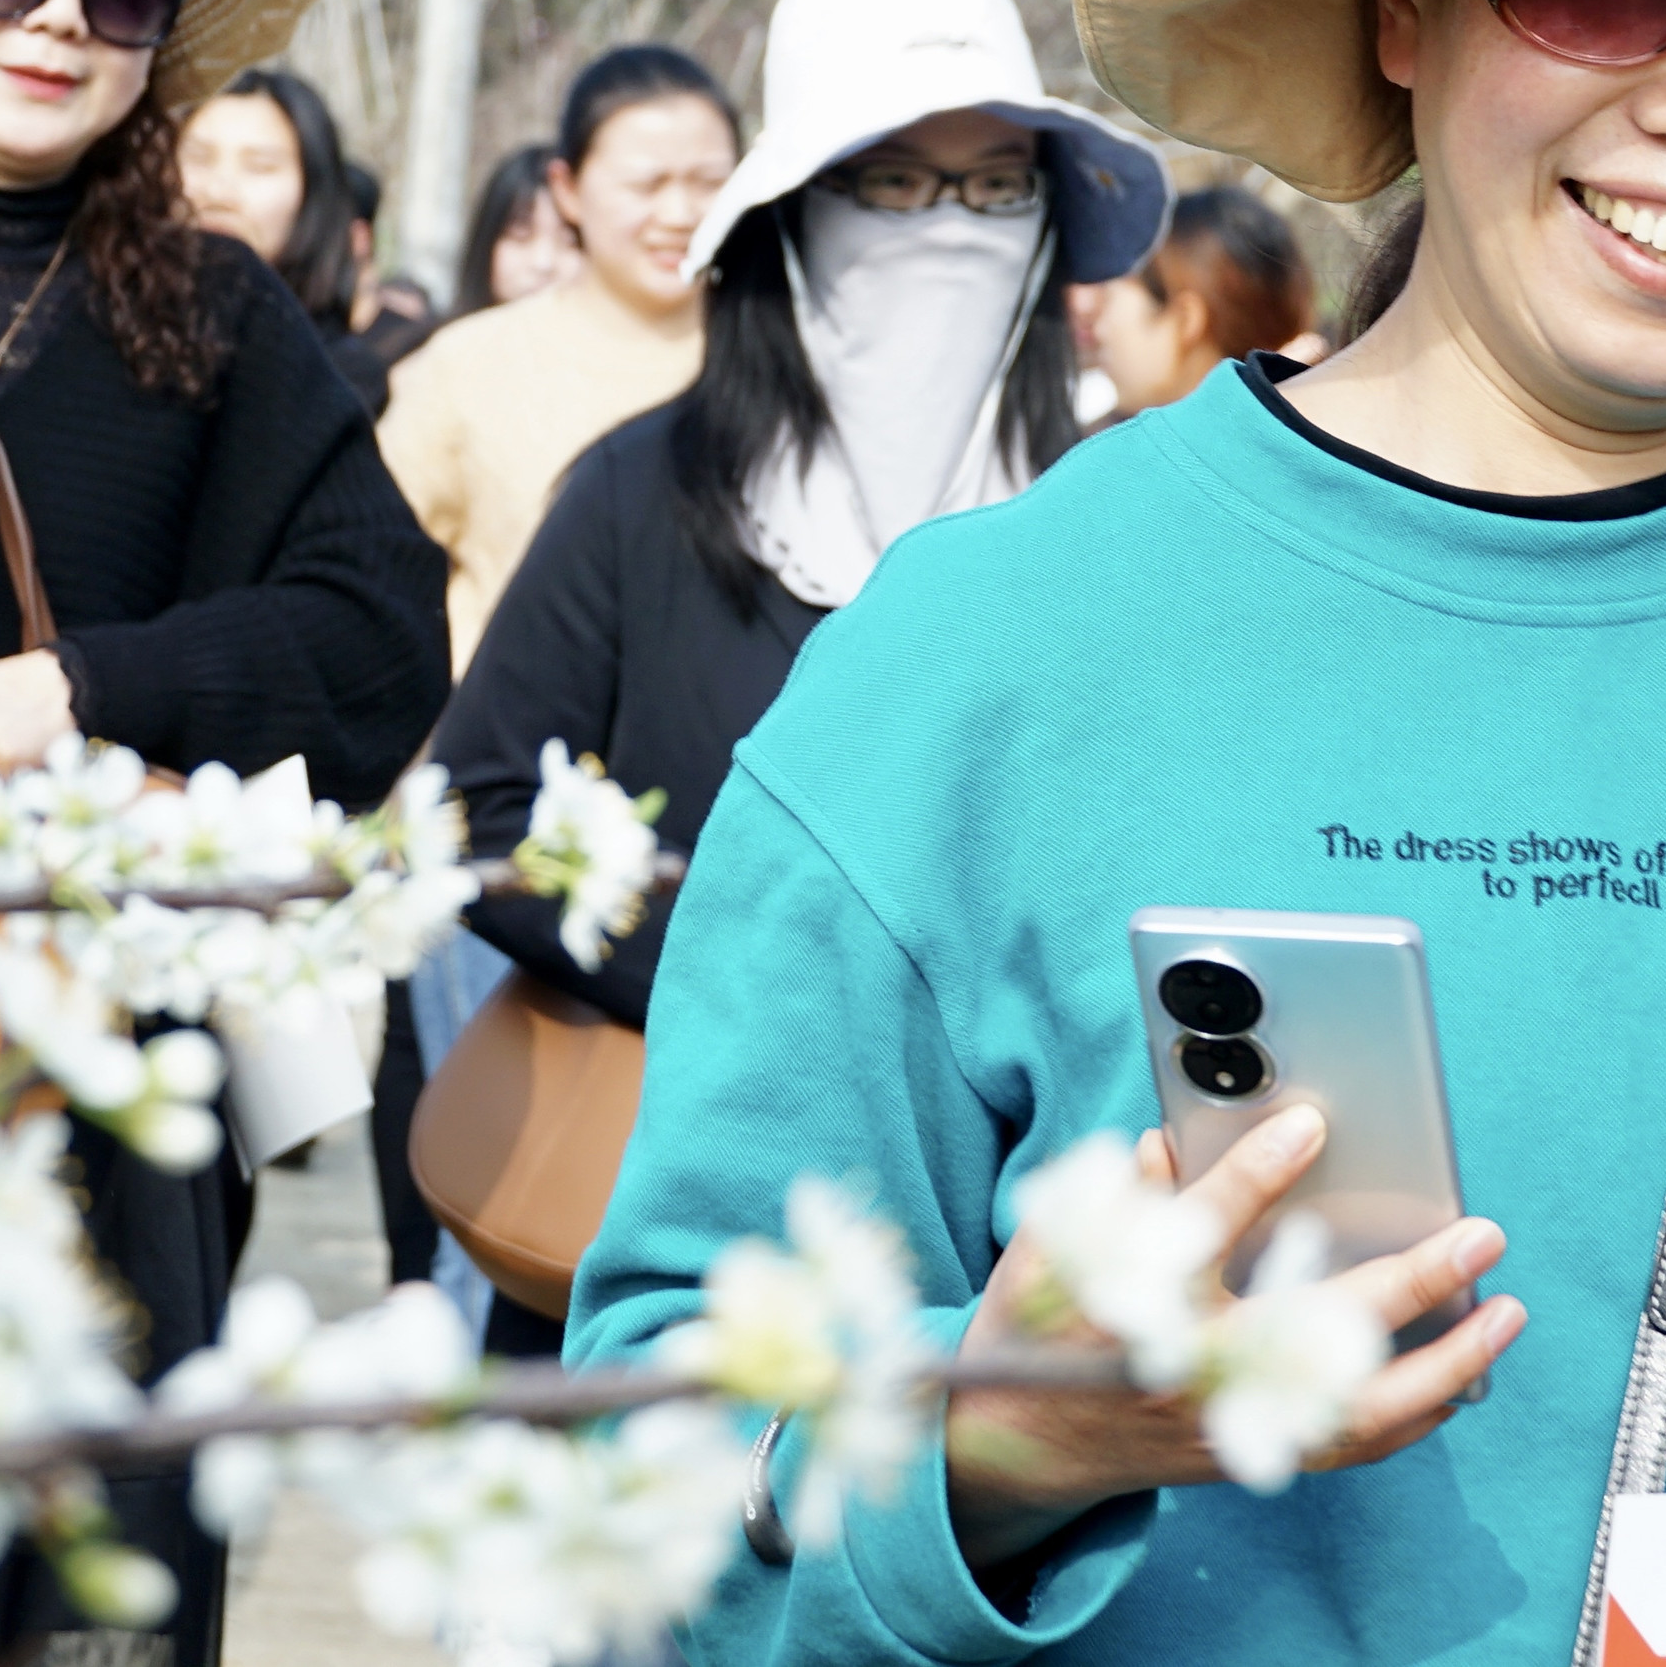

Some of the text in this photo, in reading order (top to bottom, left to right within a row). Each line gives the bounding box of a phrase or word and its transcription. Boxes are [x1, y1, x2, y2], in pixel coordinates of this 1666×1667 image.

[1317, 823, 1381, 861] The
[1394, 830, 1498, 864] dress
[1508, 831, 1622, 867] shows
[1483, 867, 1517, 899] to
